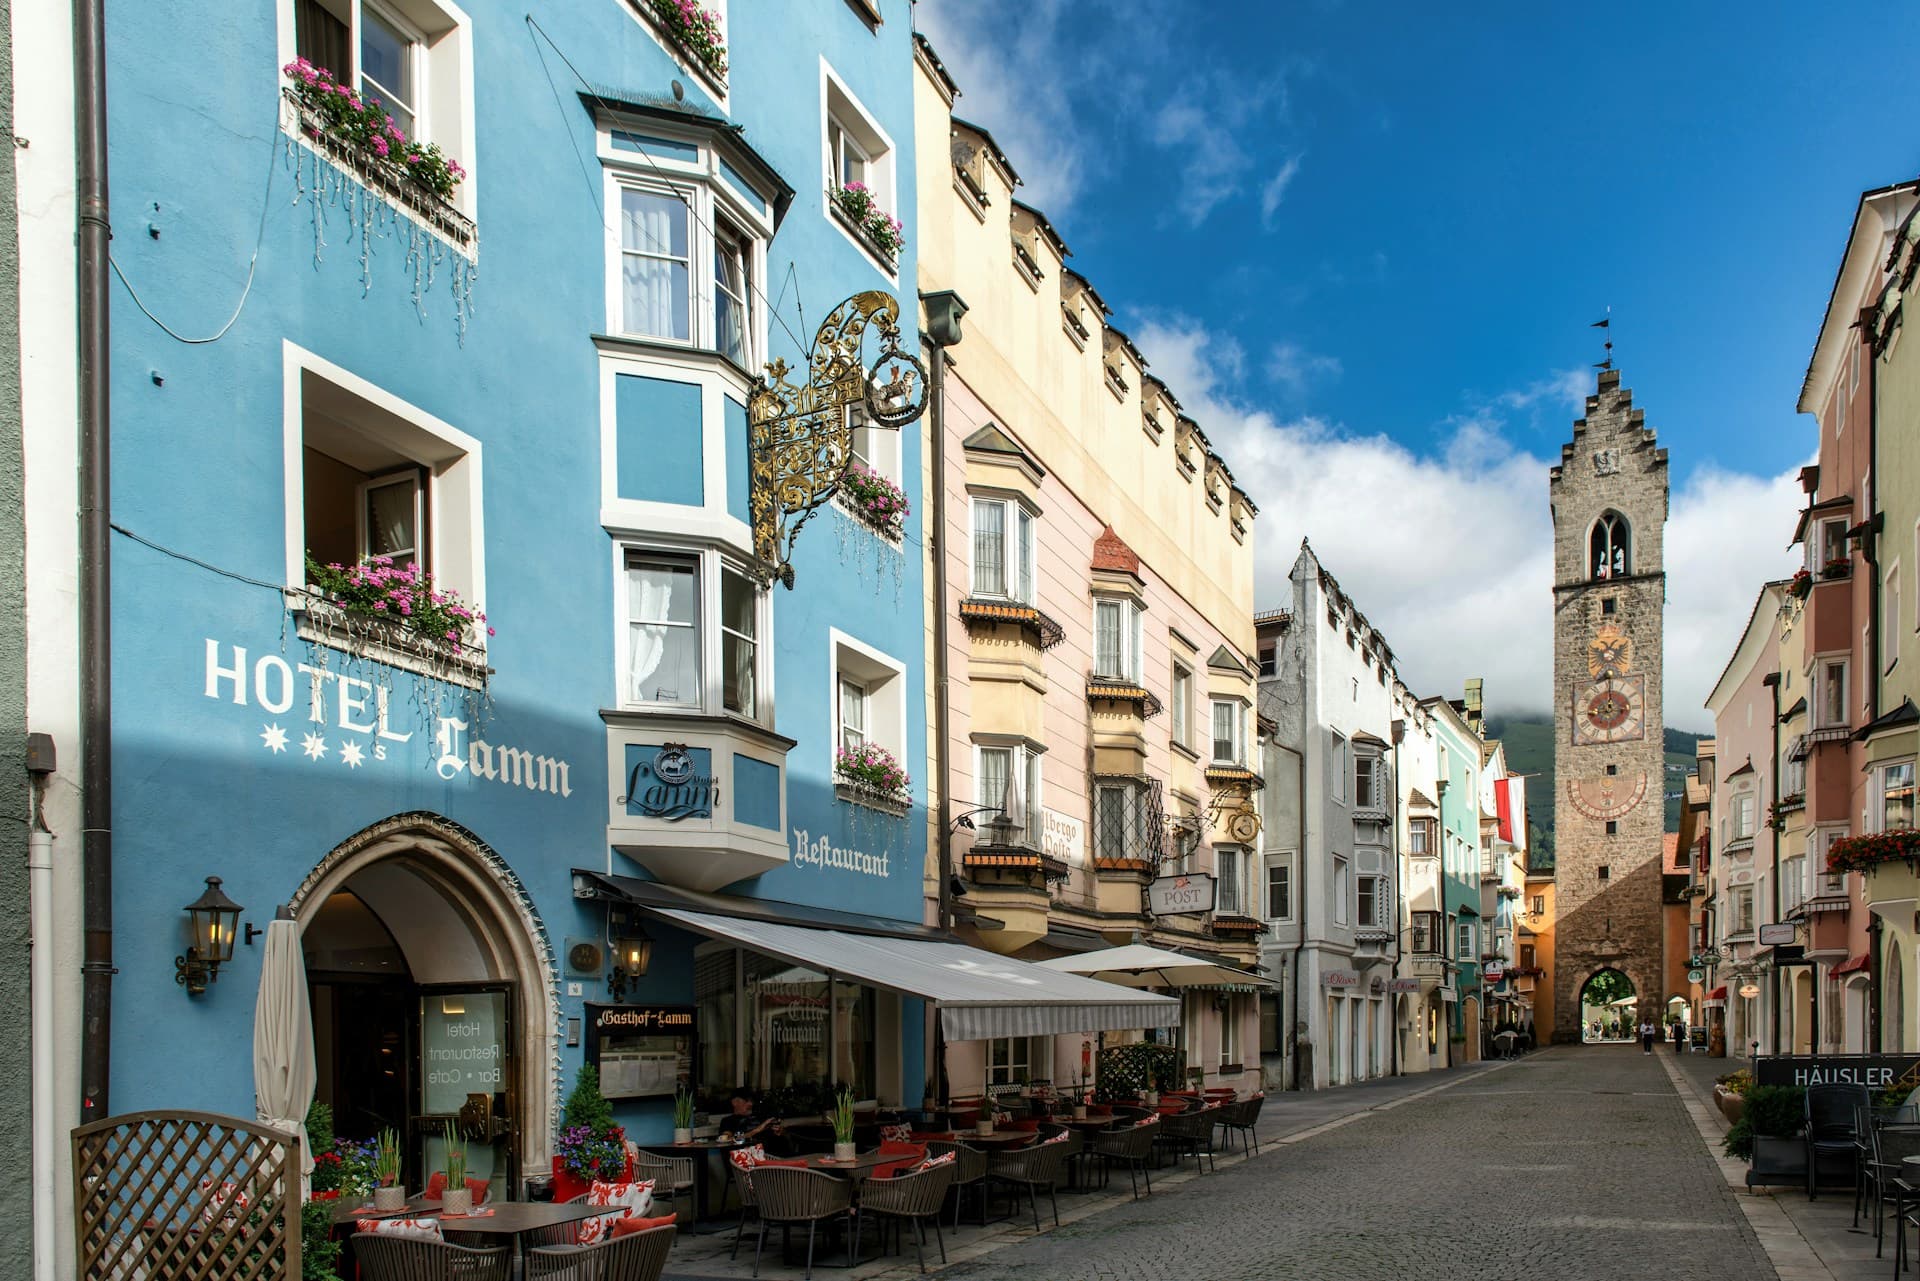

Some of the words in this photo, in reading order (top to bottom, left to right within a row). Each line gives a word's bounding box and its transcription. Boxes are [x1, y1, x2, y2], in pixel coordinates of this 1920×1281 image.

[204, 638, 413, 743] HOTEL
[436, 716, 573, 798] Lamm
[616, 761, 722, 815] Lamm
[1163, 890, 1201, 906] POST
[602, 1009, 692, 1027] Gasthof-Lamm
[1795, 1064, 1894, 1086] HÄUSLER
